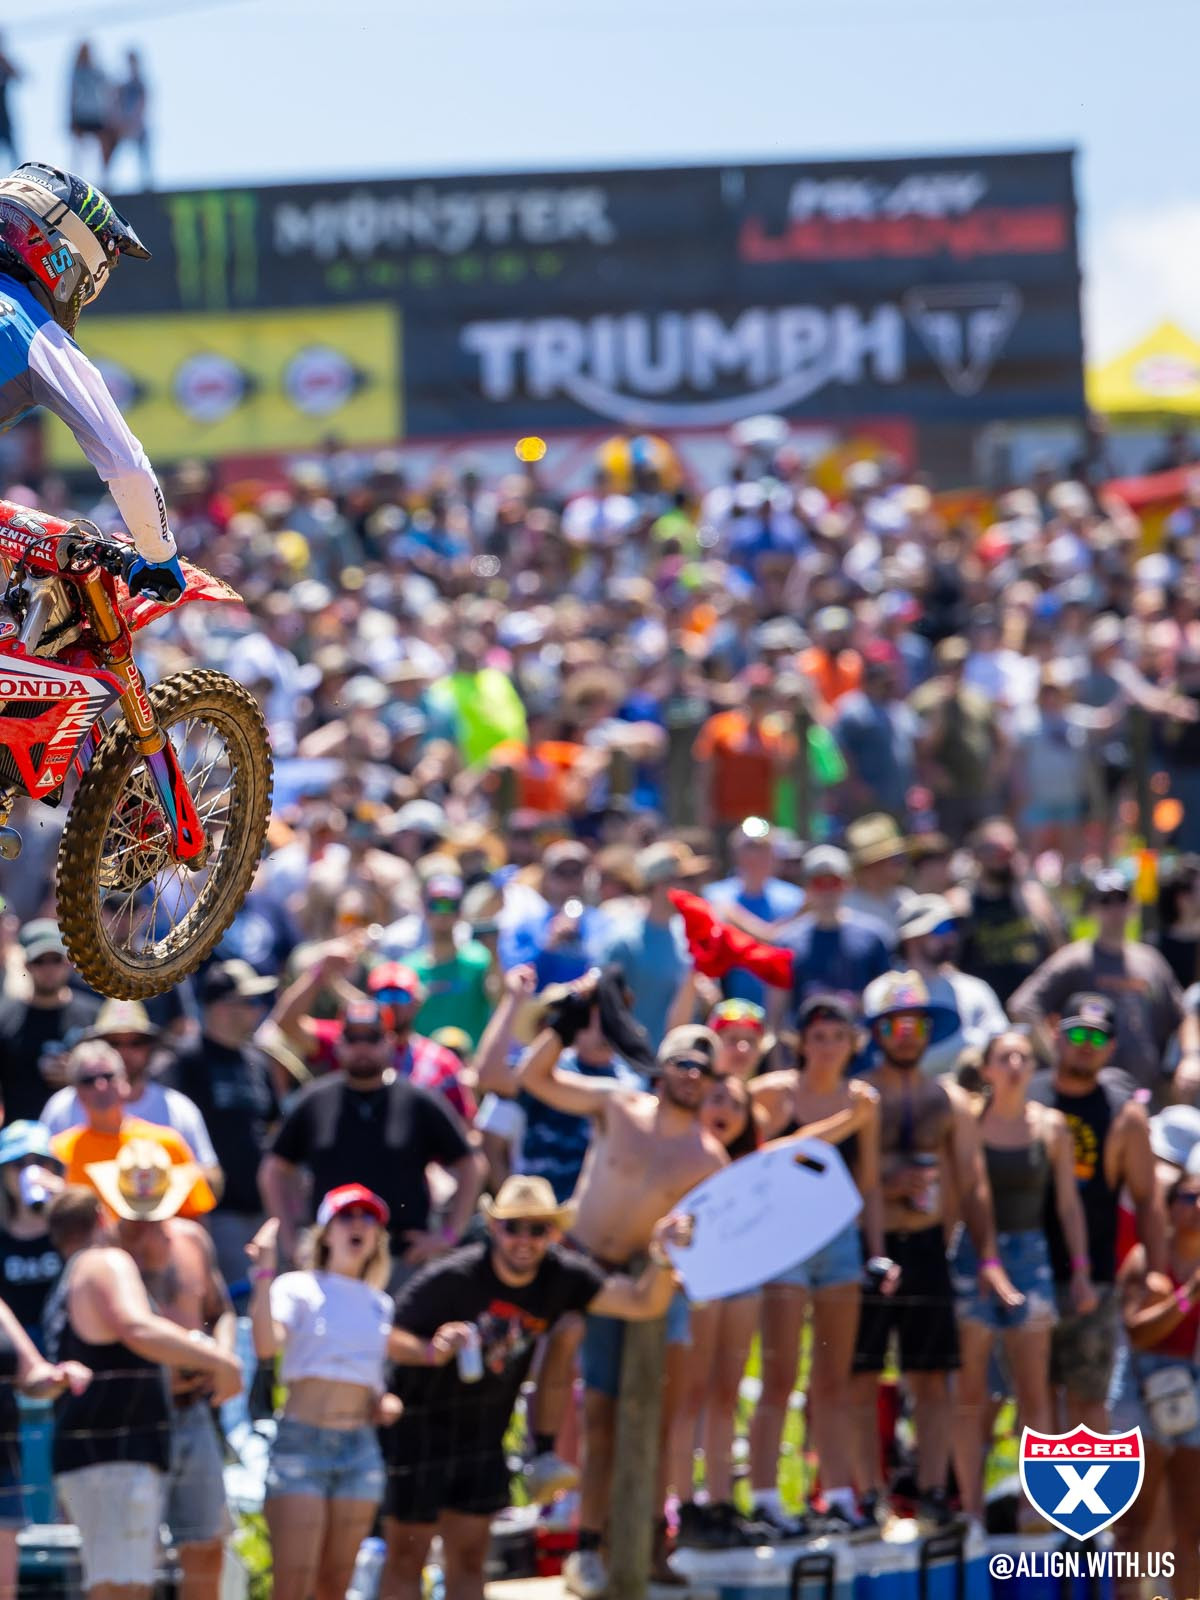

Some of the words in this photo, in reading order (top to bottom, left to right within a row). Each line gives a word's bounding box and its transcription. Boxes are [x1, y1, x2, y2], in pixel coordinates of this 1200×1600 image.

[15, 172, 54, 192] HONDA
[460, 303, 904, 424] TRIUMPH
[48, 698, 106, 745] CRF
